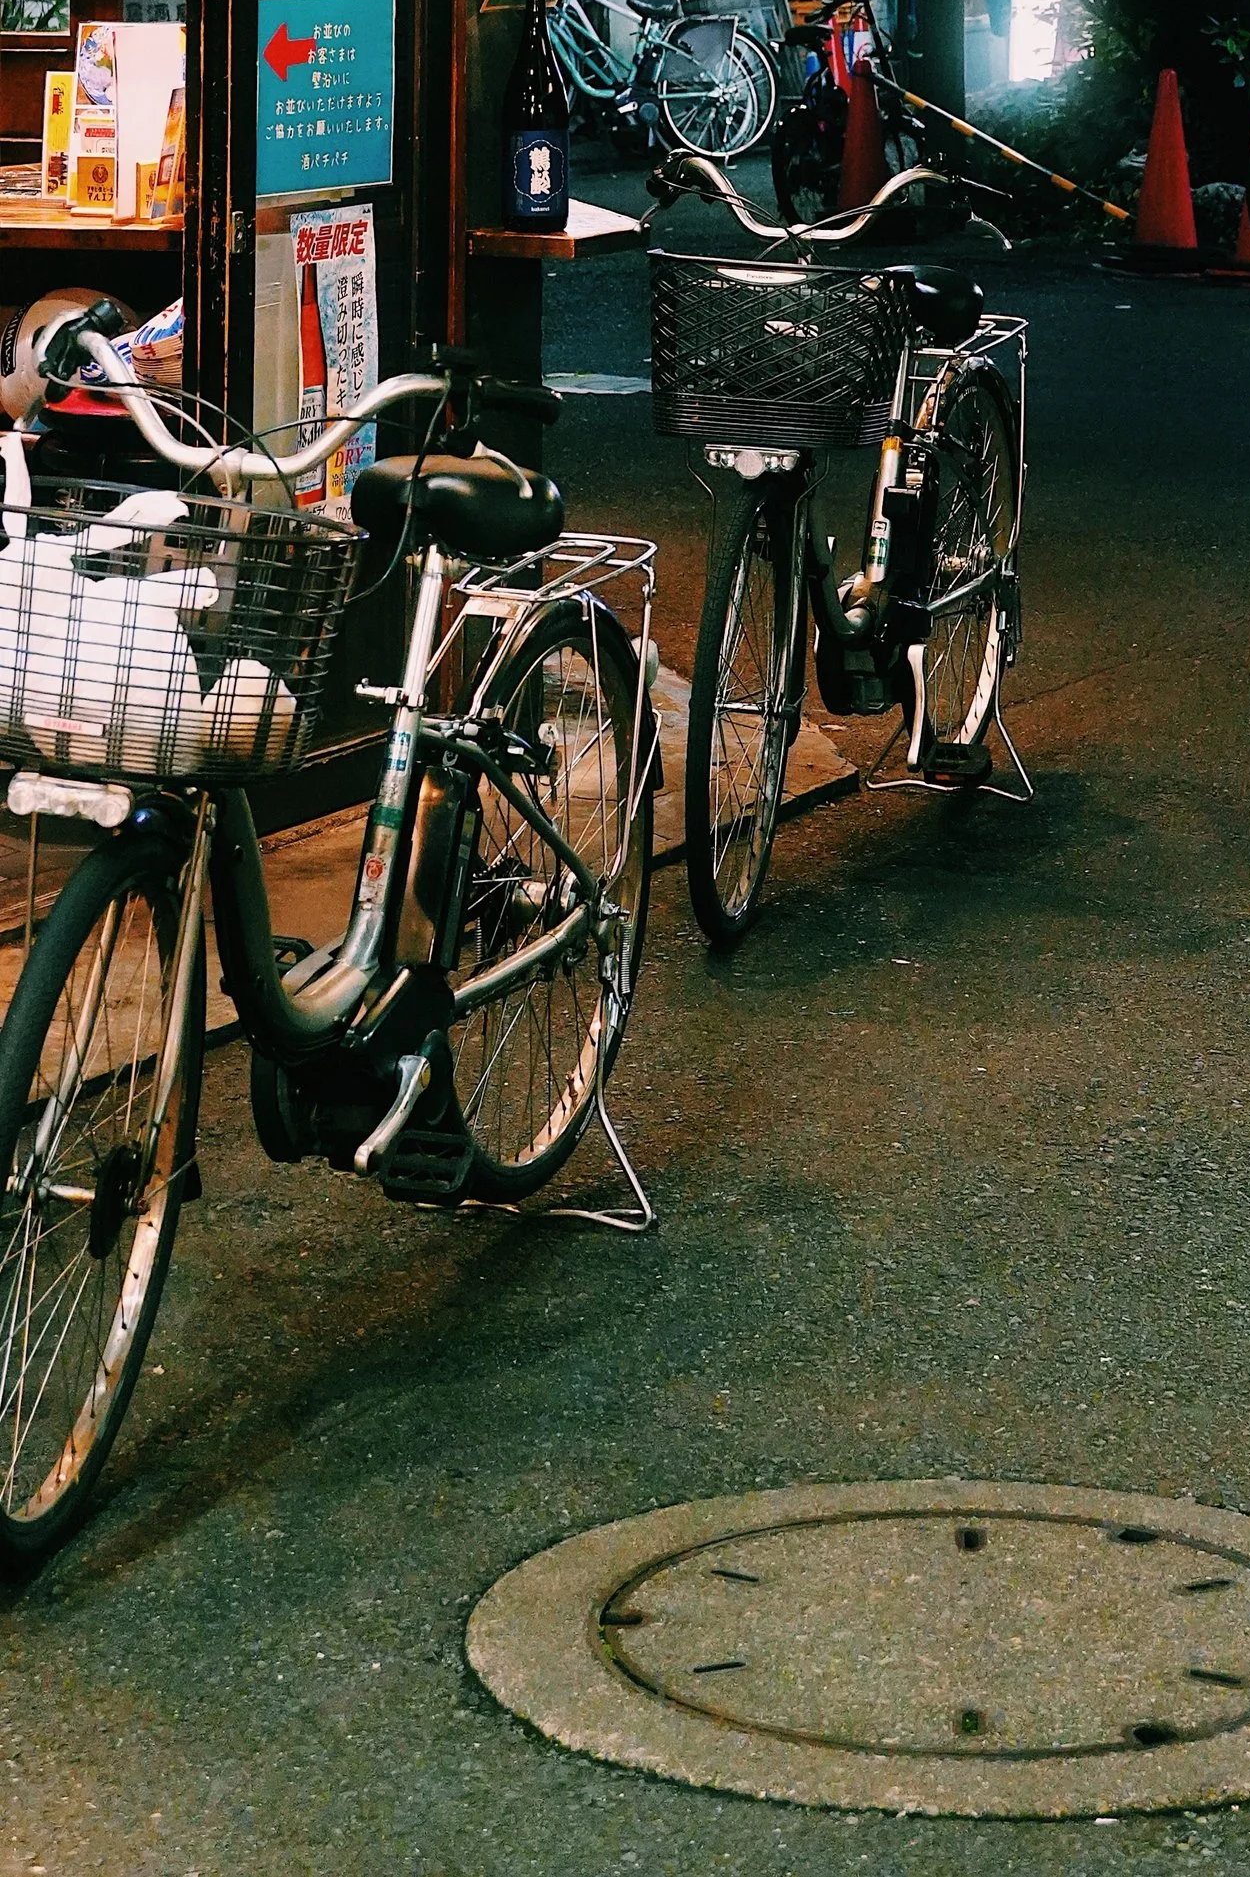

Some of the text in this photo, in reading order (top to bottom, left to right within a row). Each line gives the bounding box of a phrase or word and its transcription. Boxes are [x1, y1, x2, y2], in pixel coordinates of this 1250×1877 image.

[313, 23, 351, 39] お並びの
[307, 47, 356, 65] お客さまは
[311, 71, 350, 89] 壁沿いに
[275, 92, 382, 115] お並びいただけますよう
[265, 115, 389, 140] ご協力をお願いいたします。
[301, 150, 349, 171] 酒パチパチ
[296, 219, 369, 265] 数量限定
[300, 404, 316, 420] DRY
[334, 446, 366, 468] DRY
